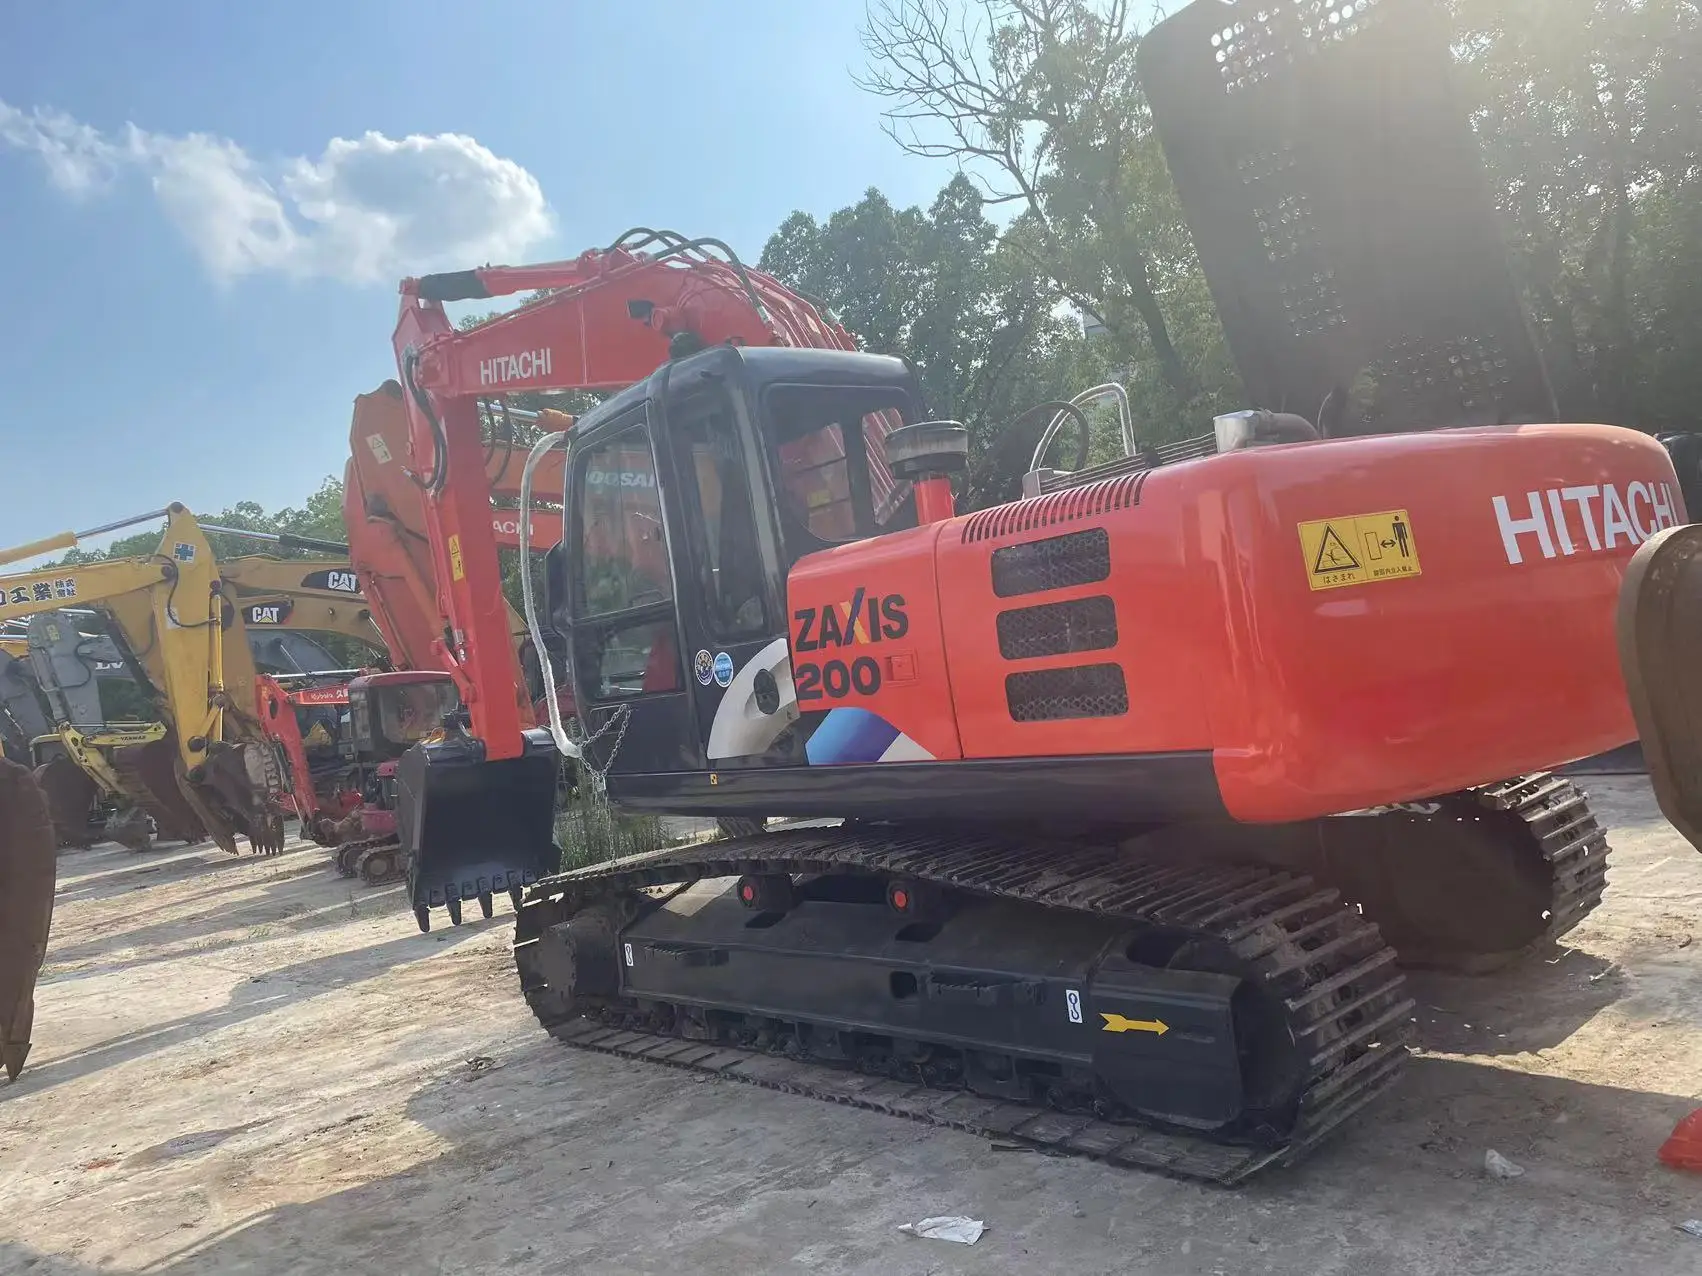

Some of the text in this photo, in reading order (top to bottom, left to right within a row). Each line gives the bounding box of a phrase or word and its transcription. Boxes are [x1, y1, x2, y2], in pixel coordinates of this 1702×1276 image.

[480, 347, 551, 385] HITACHI
[1492, 481, 1679, 565] HITACHI
[327, 571, 357, 592] CAT
[1322, 572, 1356, 584] はさまれ
[252, 607, 279, 623] CAT
[794, 587, 909, 652] ZAXIS
[795, 656, 882, 700] 200
